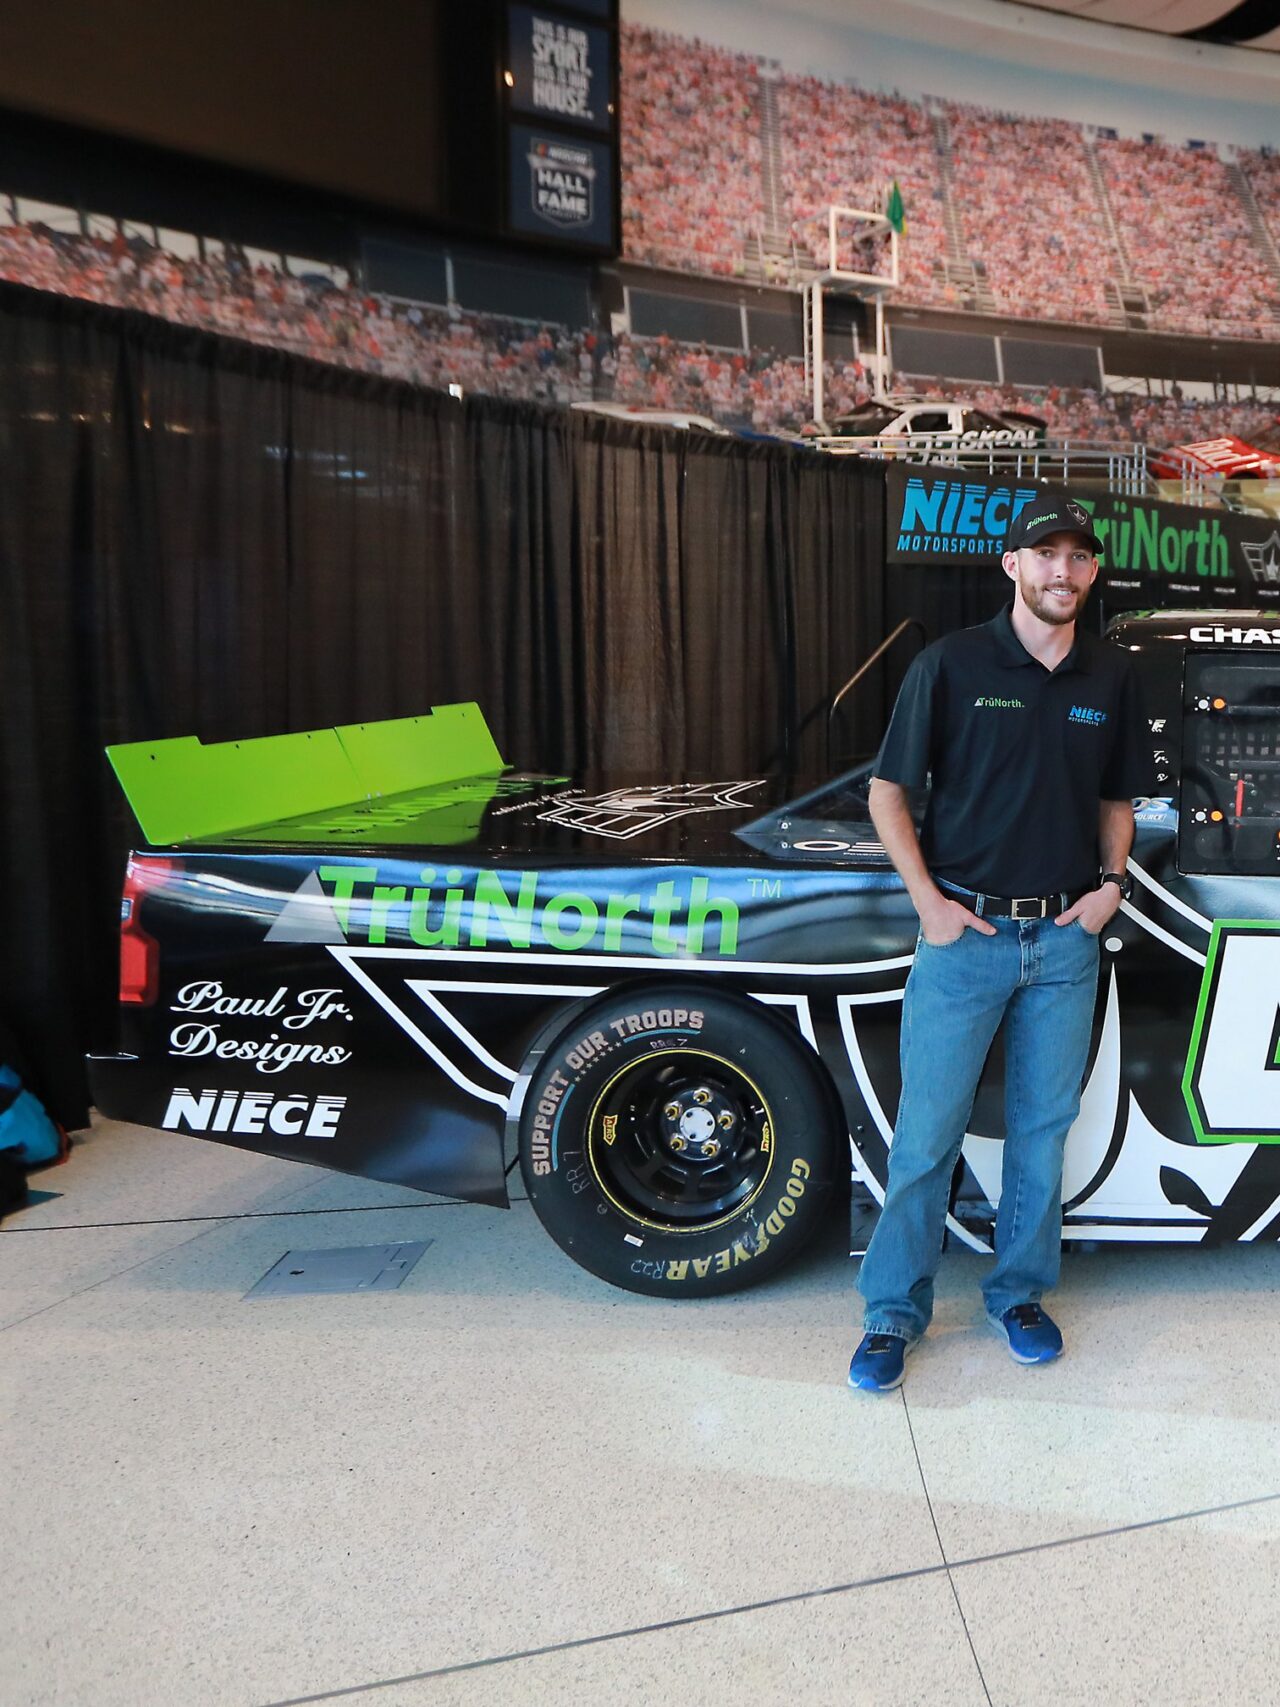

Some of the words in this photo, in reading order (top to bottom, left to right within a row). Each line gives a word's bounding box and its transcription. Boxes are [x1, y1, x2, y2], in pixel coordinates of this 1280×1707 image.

[538, 168, 587, 195] HALL
[538, 190, 587, 216] FAME
[897, 535, 1003, 554] MOTORSPORTS
[1072, 498, 1230, 578] rüNorth
[318, 866, 740, 955] TrüNorth
[170, 980, 288, 1016] Paul
[282, 988, 354, 1030] Jr.
[168, 1022, 353, 1074] Designs
[161, 1087, 348, 1138] NIECE
[531, 1069, 570, 1177] SUPPORT
[564, 1031, 611, 1070] OUR
[610, 1008, 705, 1038] TROOPS
[666, 1157, 811, 1281] GOODYEAR
